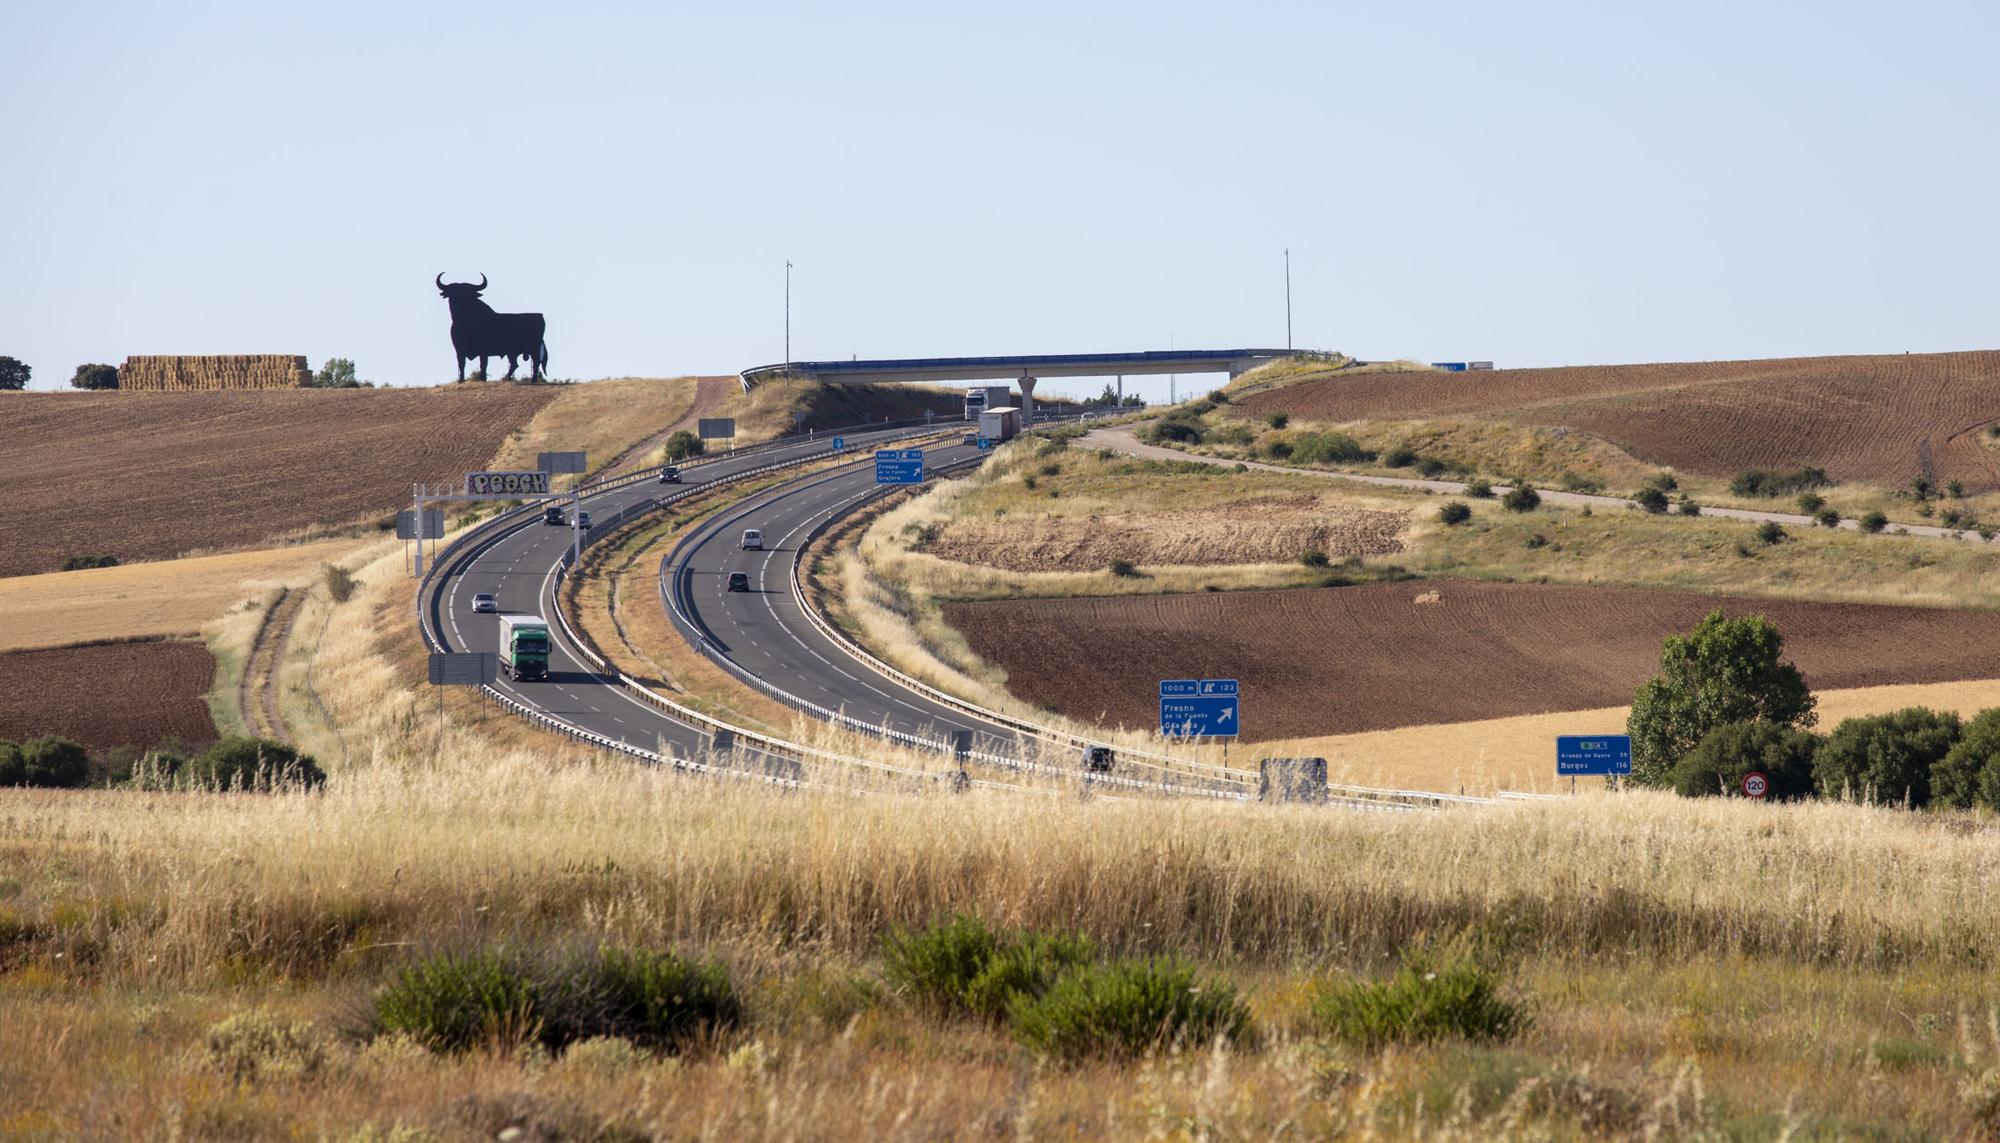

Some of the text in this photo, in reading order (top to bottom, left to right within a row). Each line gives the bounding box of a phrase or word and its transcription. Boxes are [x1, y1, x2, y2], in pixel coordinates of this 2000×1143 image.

[1164, 704, 1195, 712] Fresno
[1561, 761, 1628, 770] Burgos 116
[1747, 780, 1764, 790] 120
